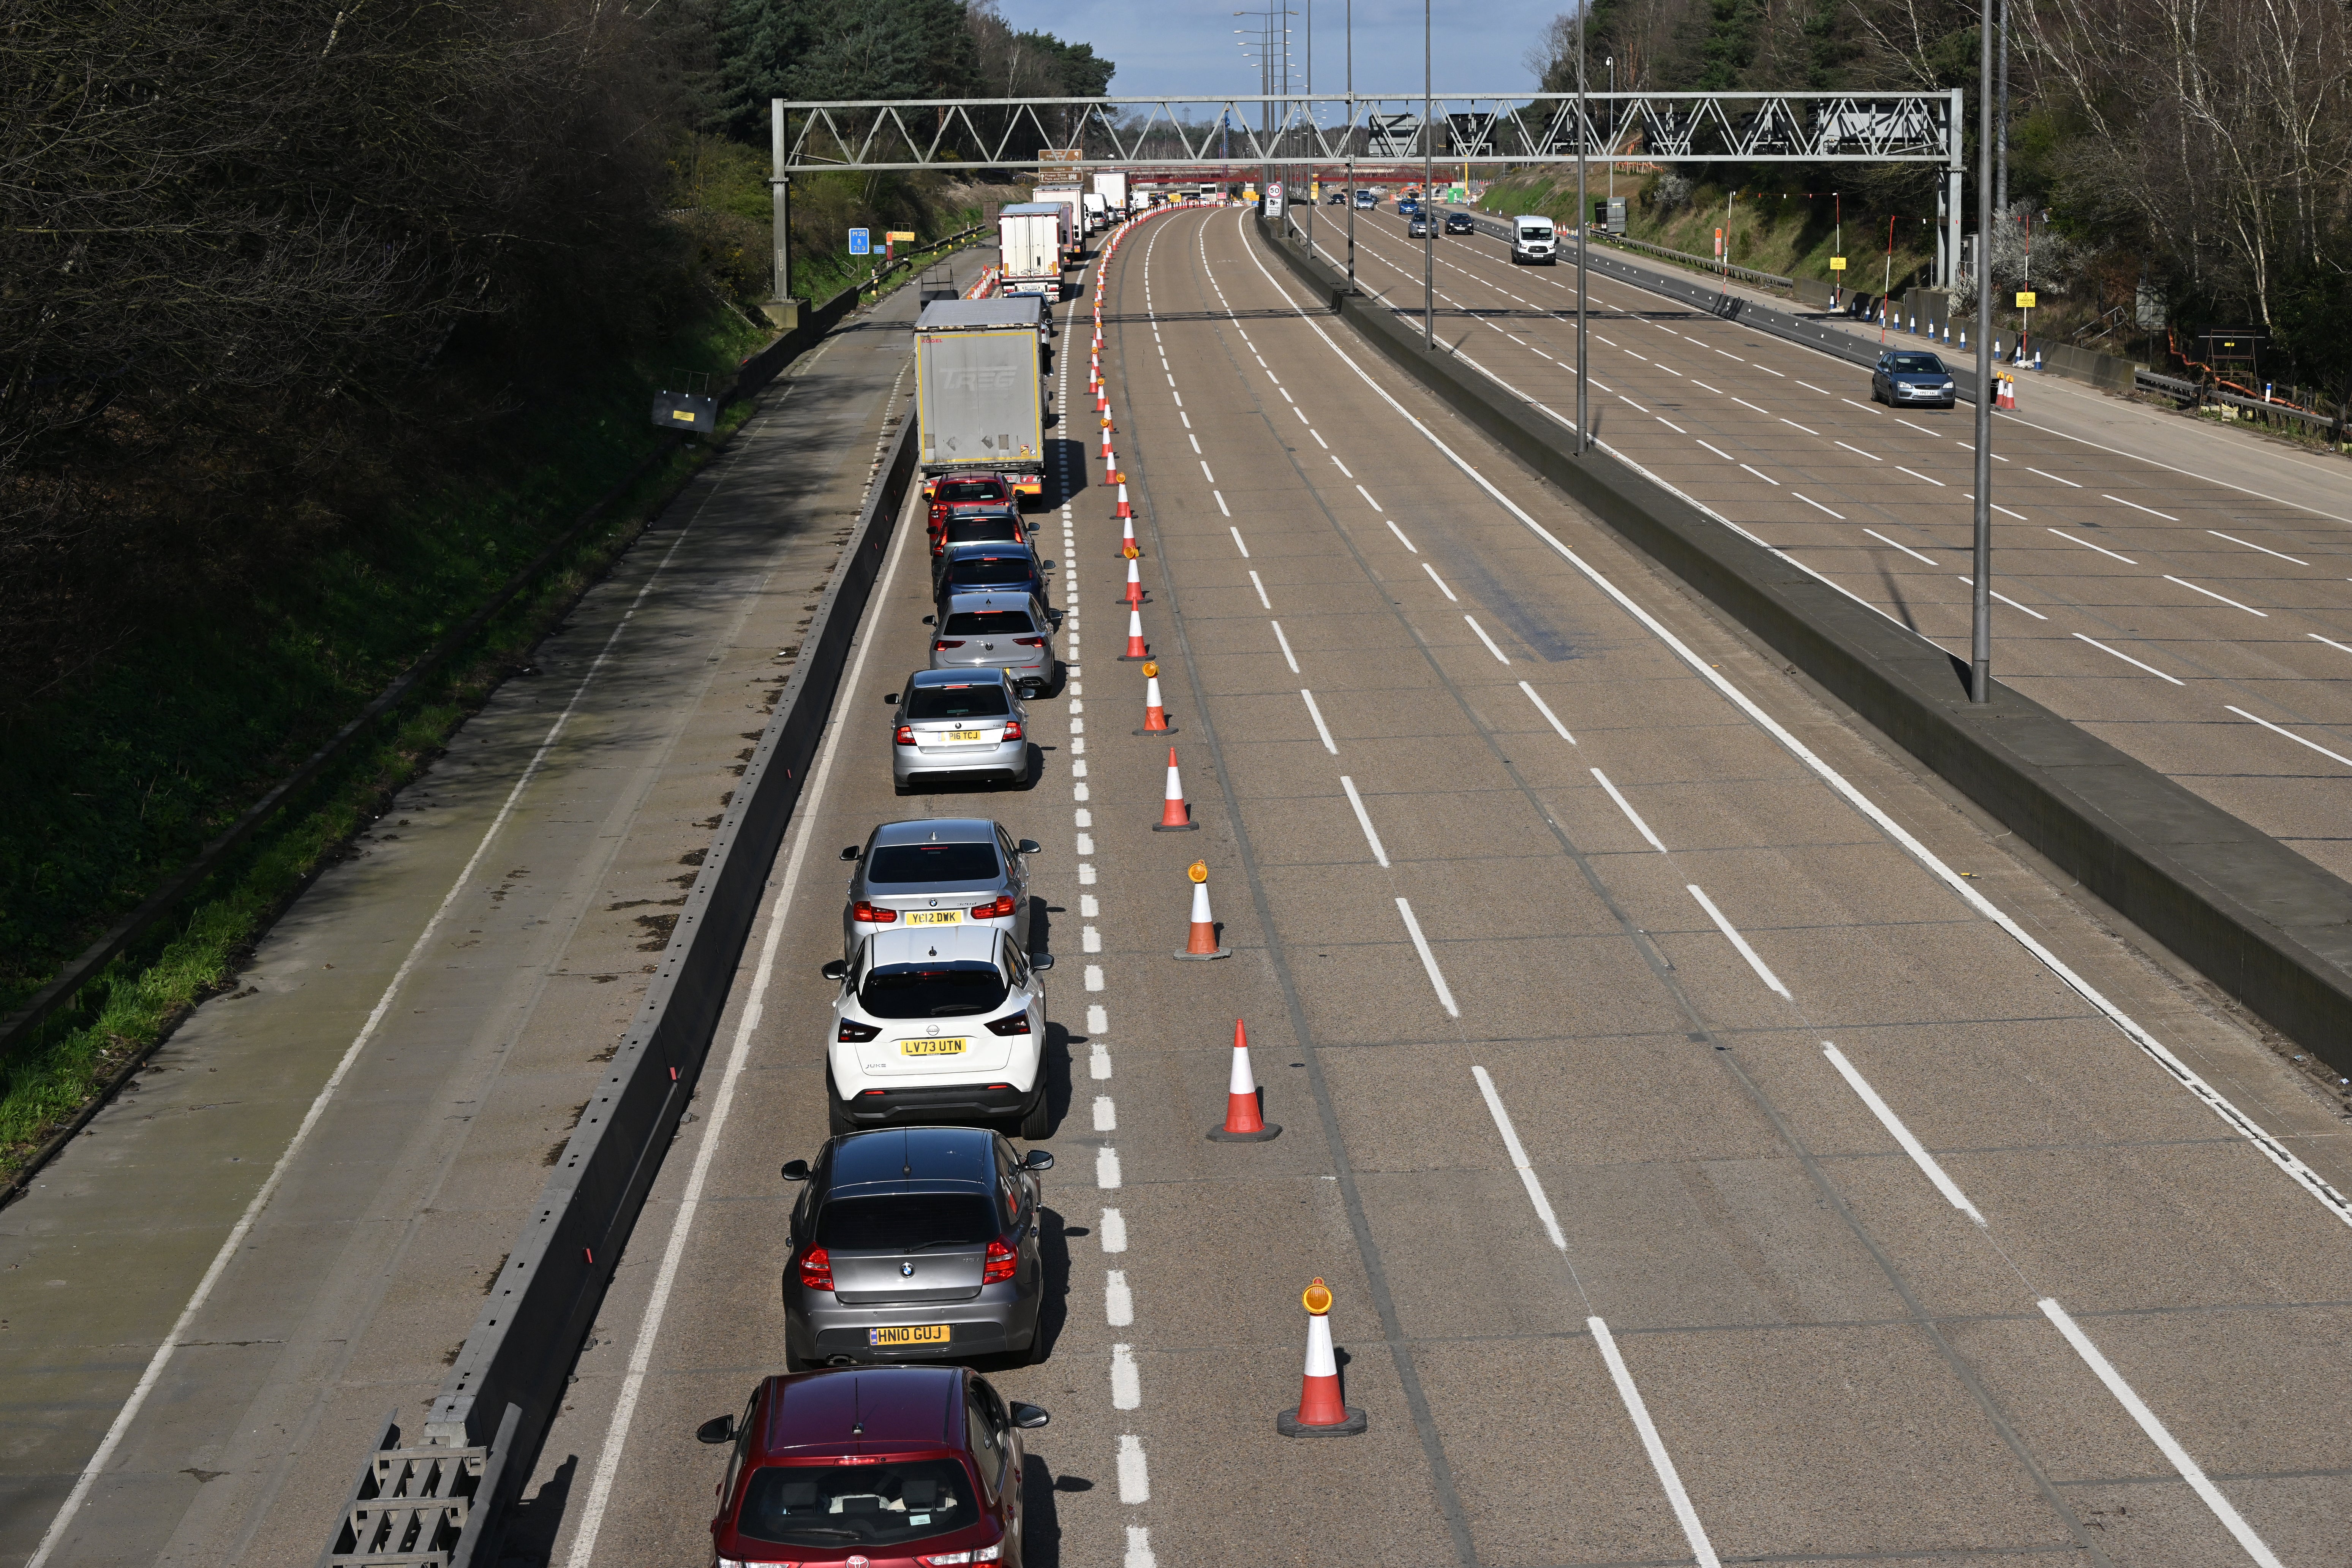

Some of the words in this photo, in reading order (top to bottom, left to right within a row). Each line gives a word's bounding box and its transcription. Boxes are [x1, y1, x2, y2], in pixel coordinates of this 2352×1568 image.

[963, 730, 978, 739] TCJ
[912, 914, 934, 923] YC12
[937, 912, 956, 922] DWK
[906, 1041, 936, 1053] LV73
[939, 1040, 962, 1051] UTN
[878, 1328, 910, 1342] HN10
[914, 1326, 941, 1340] GUJ
